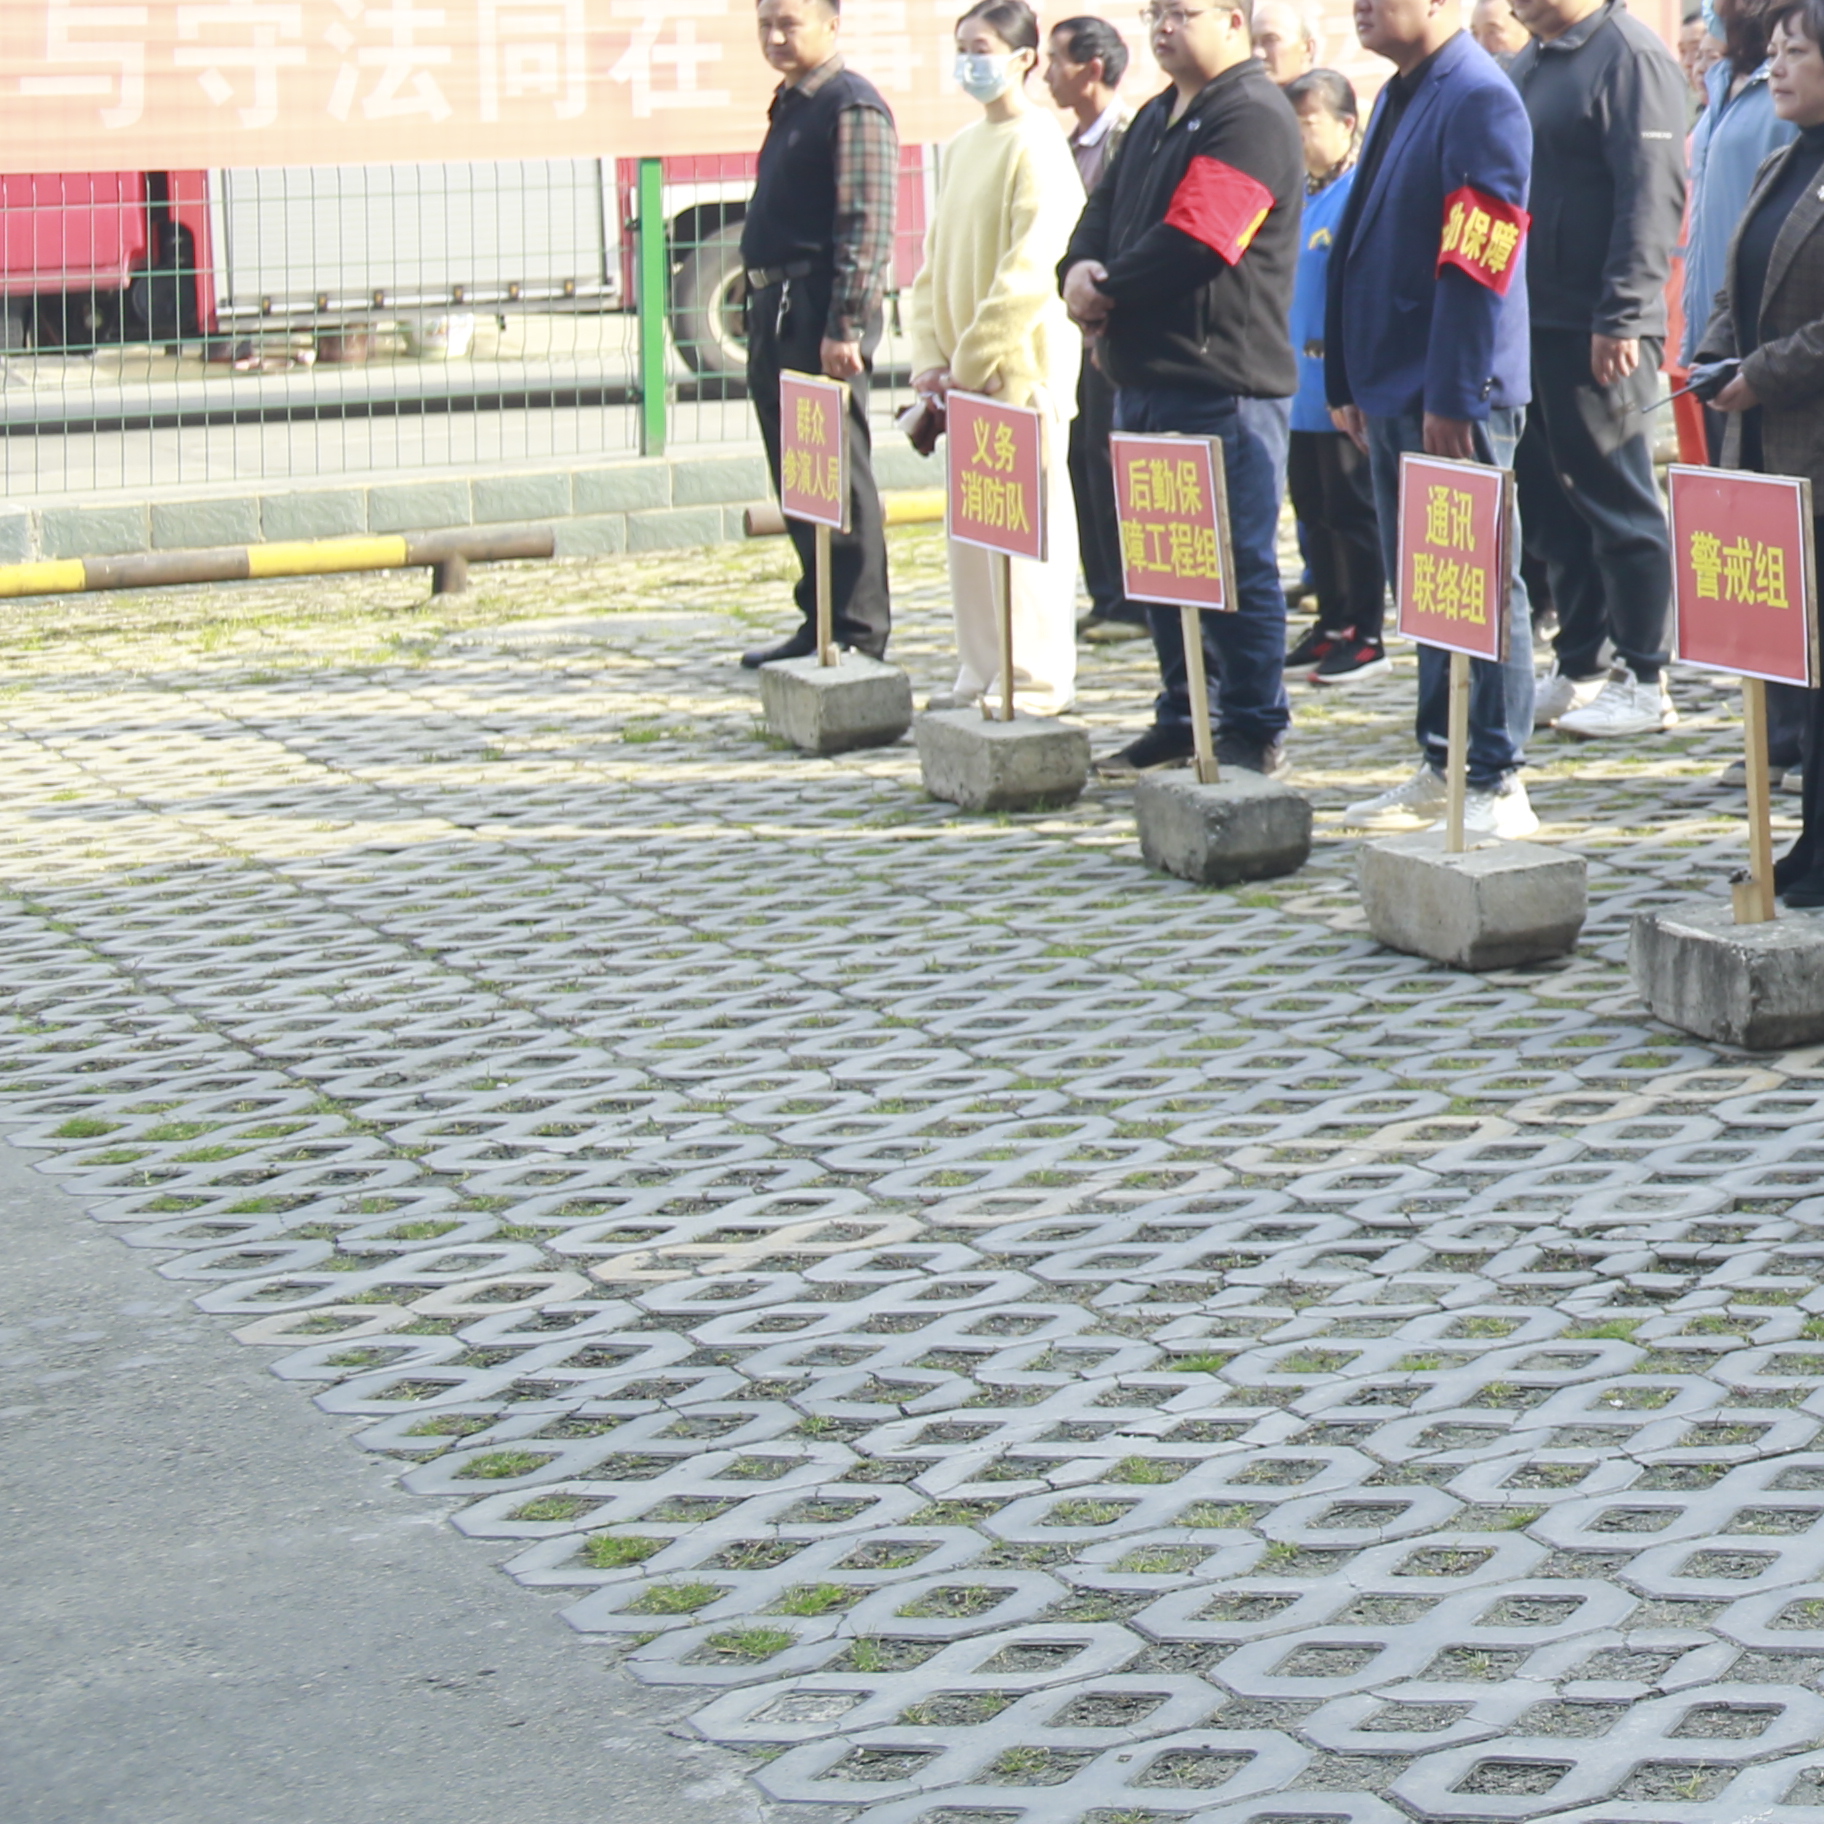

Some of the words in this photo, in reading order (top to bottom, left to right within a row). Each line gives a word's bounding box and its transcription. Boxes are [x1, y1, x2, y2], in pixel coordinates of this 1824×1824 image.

[796, 397, 827, 447] 群众
[971, 417, 1018, 474] 义务
[783, 446, 840, 503] 参演人员
[960, 470, 1031, 535] 消防队
[1127, 458, 1203, 517] 后勤保
[1122, 519, 1222, 580] 障工程组
[1425, 485, 1476, 553] 通讯
[1412, 552, 1487, 626] 联络组
[1689, 530, 1790, 611] 警戒组
